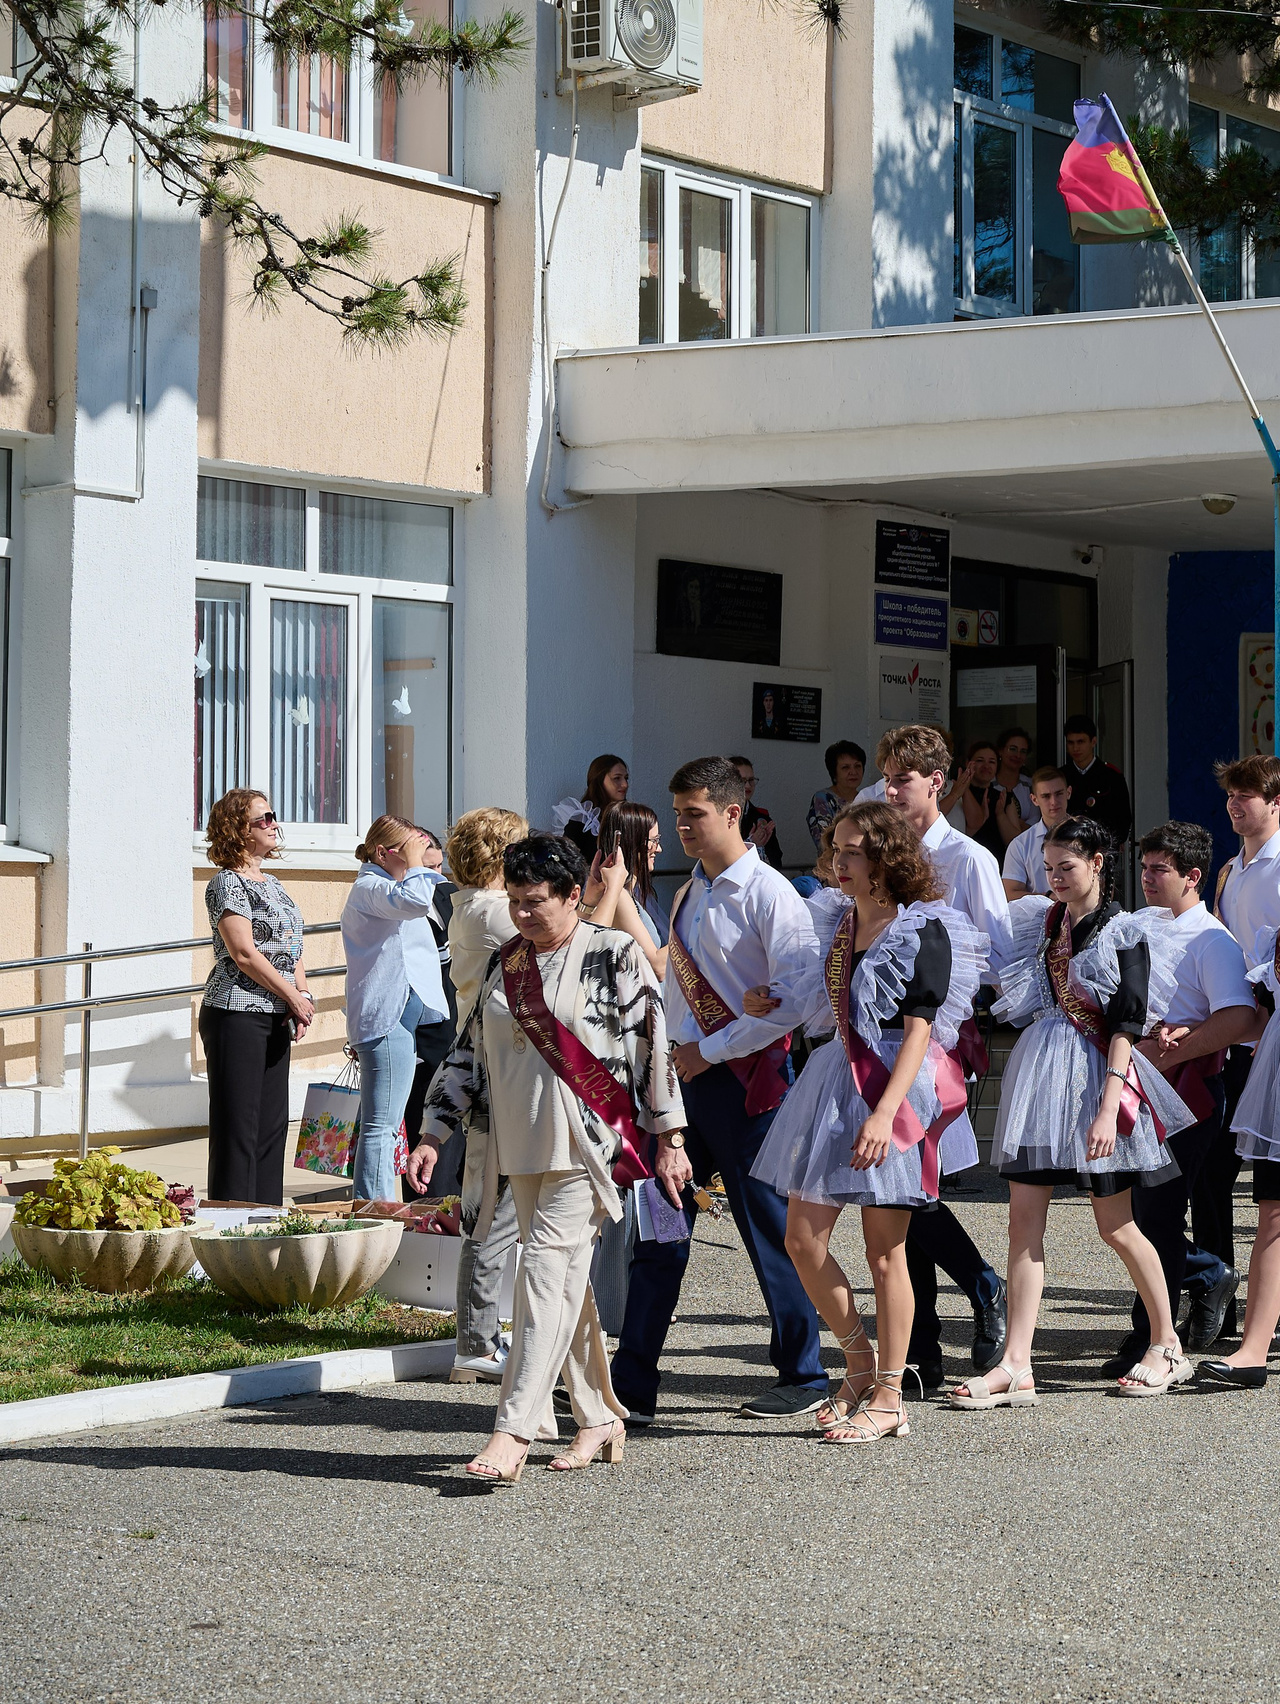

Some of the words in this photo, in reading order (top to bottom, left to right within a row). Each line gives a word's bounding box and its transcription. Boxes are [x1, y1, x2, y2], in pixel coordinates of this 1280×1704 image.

[882, 599, 902, 611] Школа
[907, 603, 942, 616] победитель
[878, 614, 911, 623] приоритетного
[912, 618, 946, 628] национального
[882, 627, 903, 635] проекта
[882, 674, 907, 685] ТОЧКА
[918, 677, 942, 688] РОСТА
[694, 993, 728, 1026] 2024
[571, 1063, 619, 1106] 2024
